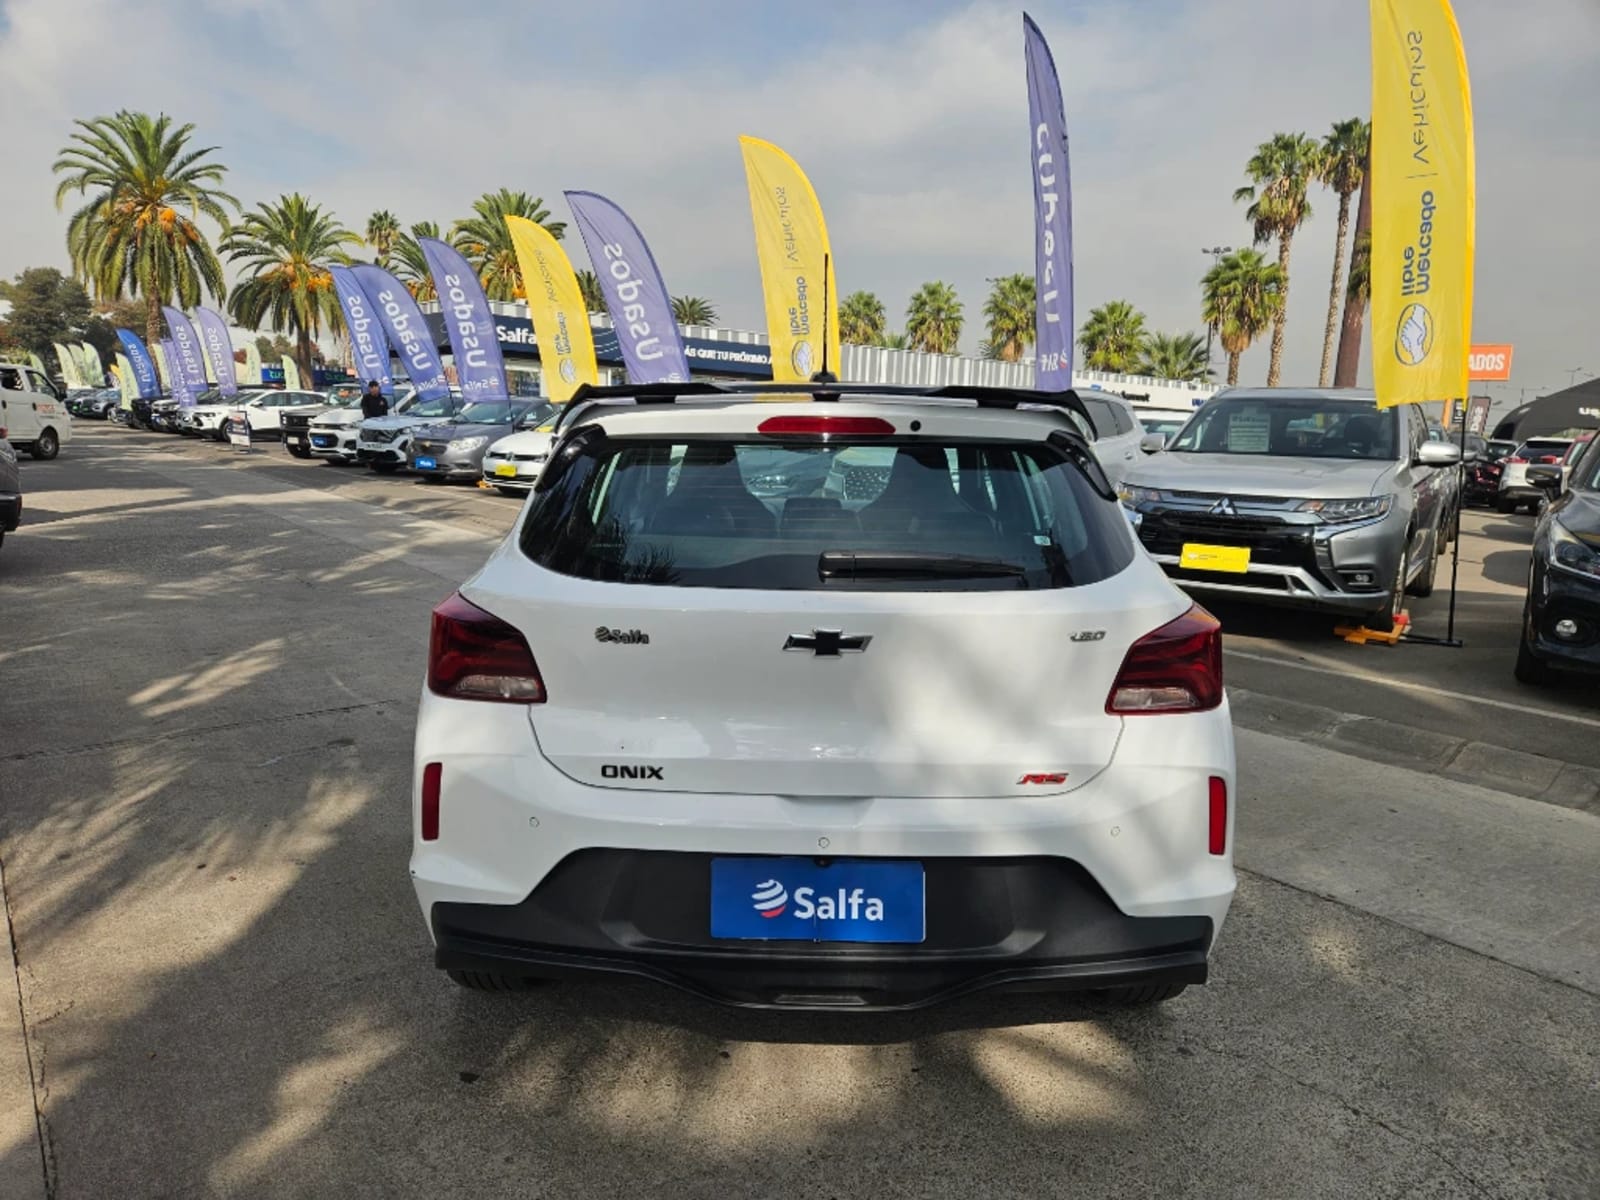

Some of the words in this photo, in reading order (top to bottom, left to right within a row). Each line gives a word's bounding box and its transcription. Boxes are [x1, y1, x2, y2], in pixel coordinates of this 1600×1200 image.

[496, 325, 537, 344] Salfa
[697, 348, 716, 360] QUE
[716, 350, 729, 361] TU
[601, 765, 664, 780] ONIX
[793, 886, 884, 921] Salfa
